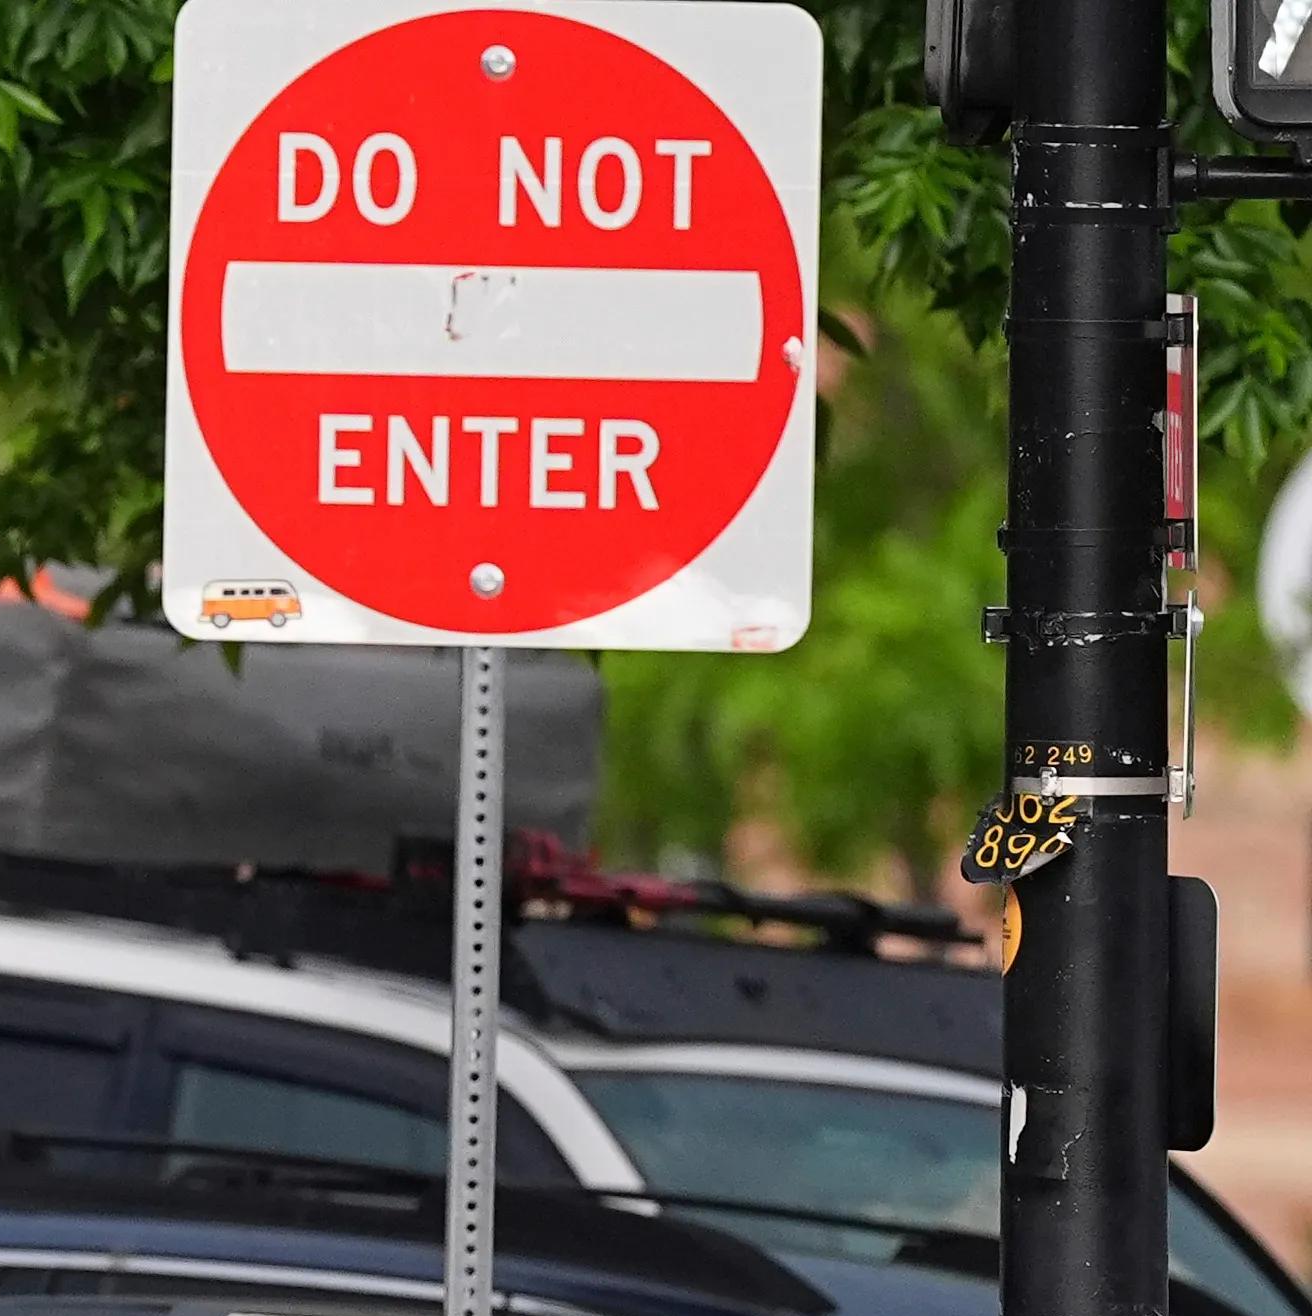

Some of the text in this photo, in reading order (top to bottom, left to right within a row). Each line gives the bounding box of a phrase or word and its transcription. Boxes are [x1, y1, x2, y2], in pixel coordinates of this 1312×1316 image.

[277, 131, 713, 231] DO NOT
[318, 413, 661, 512] ENTER
[1047, 743, 1093, 766] 249
